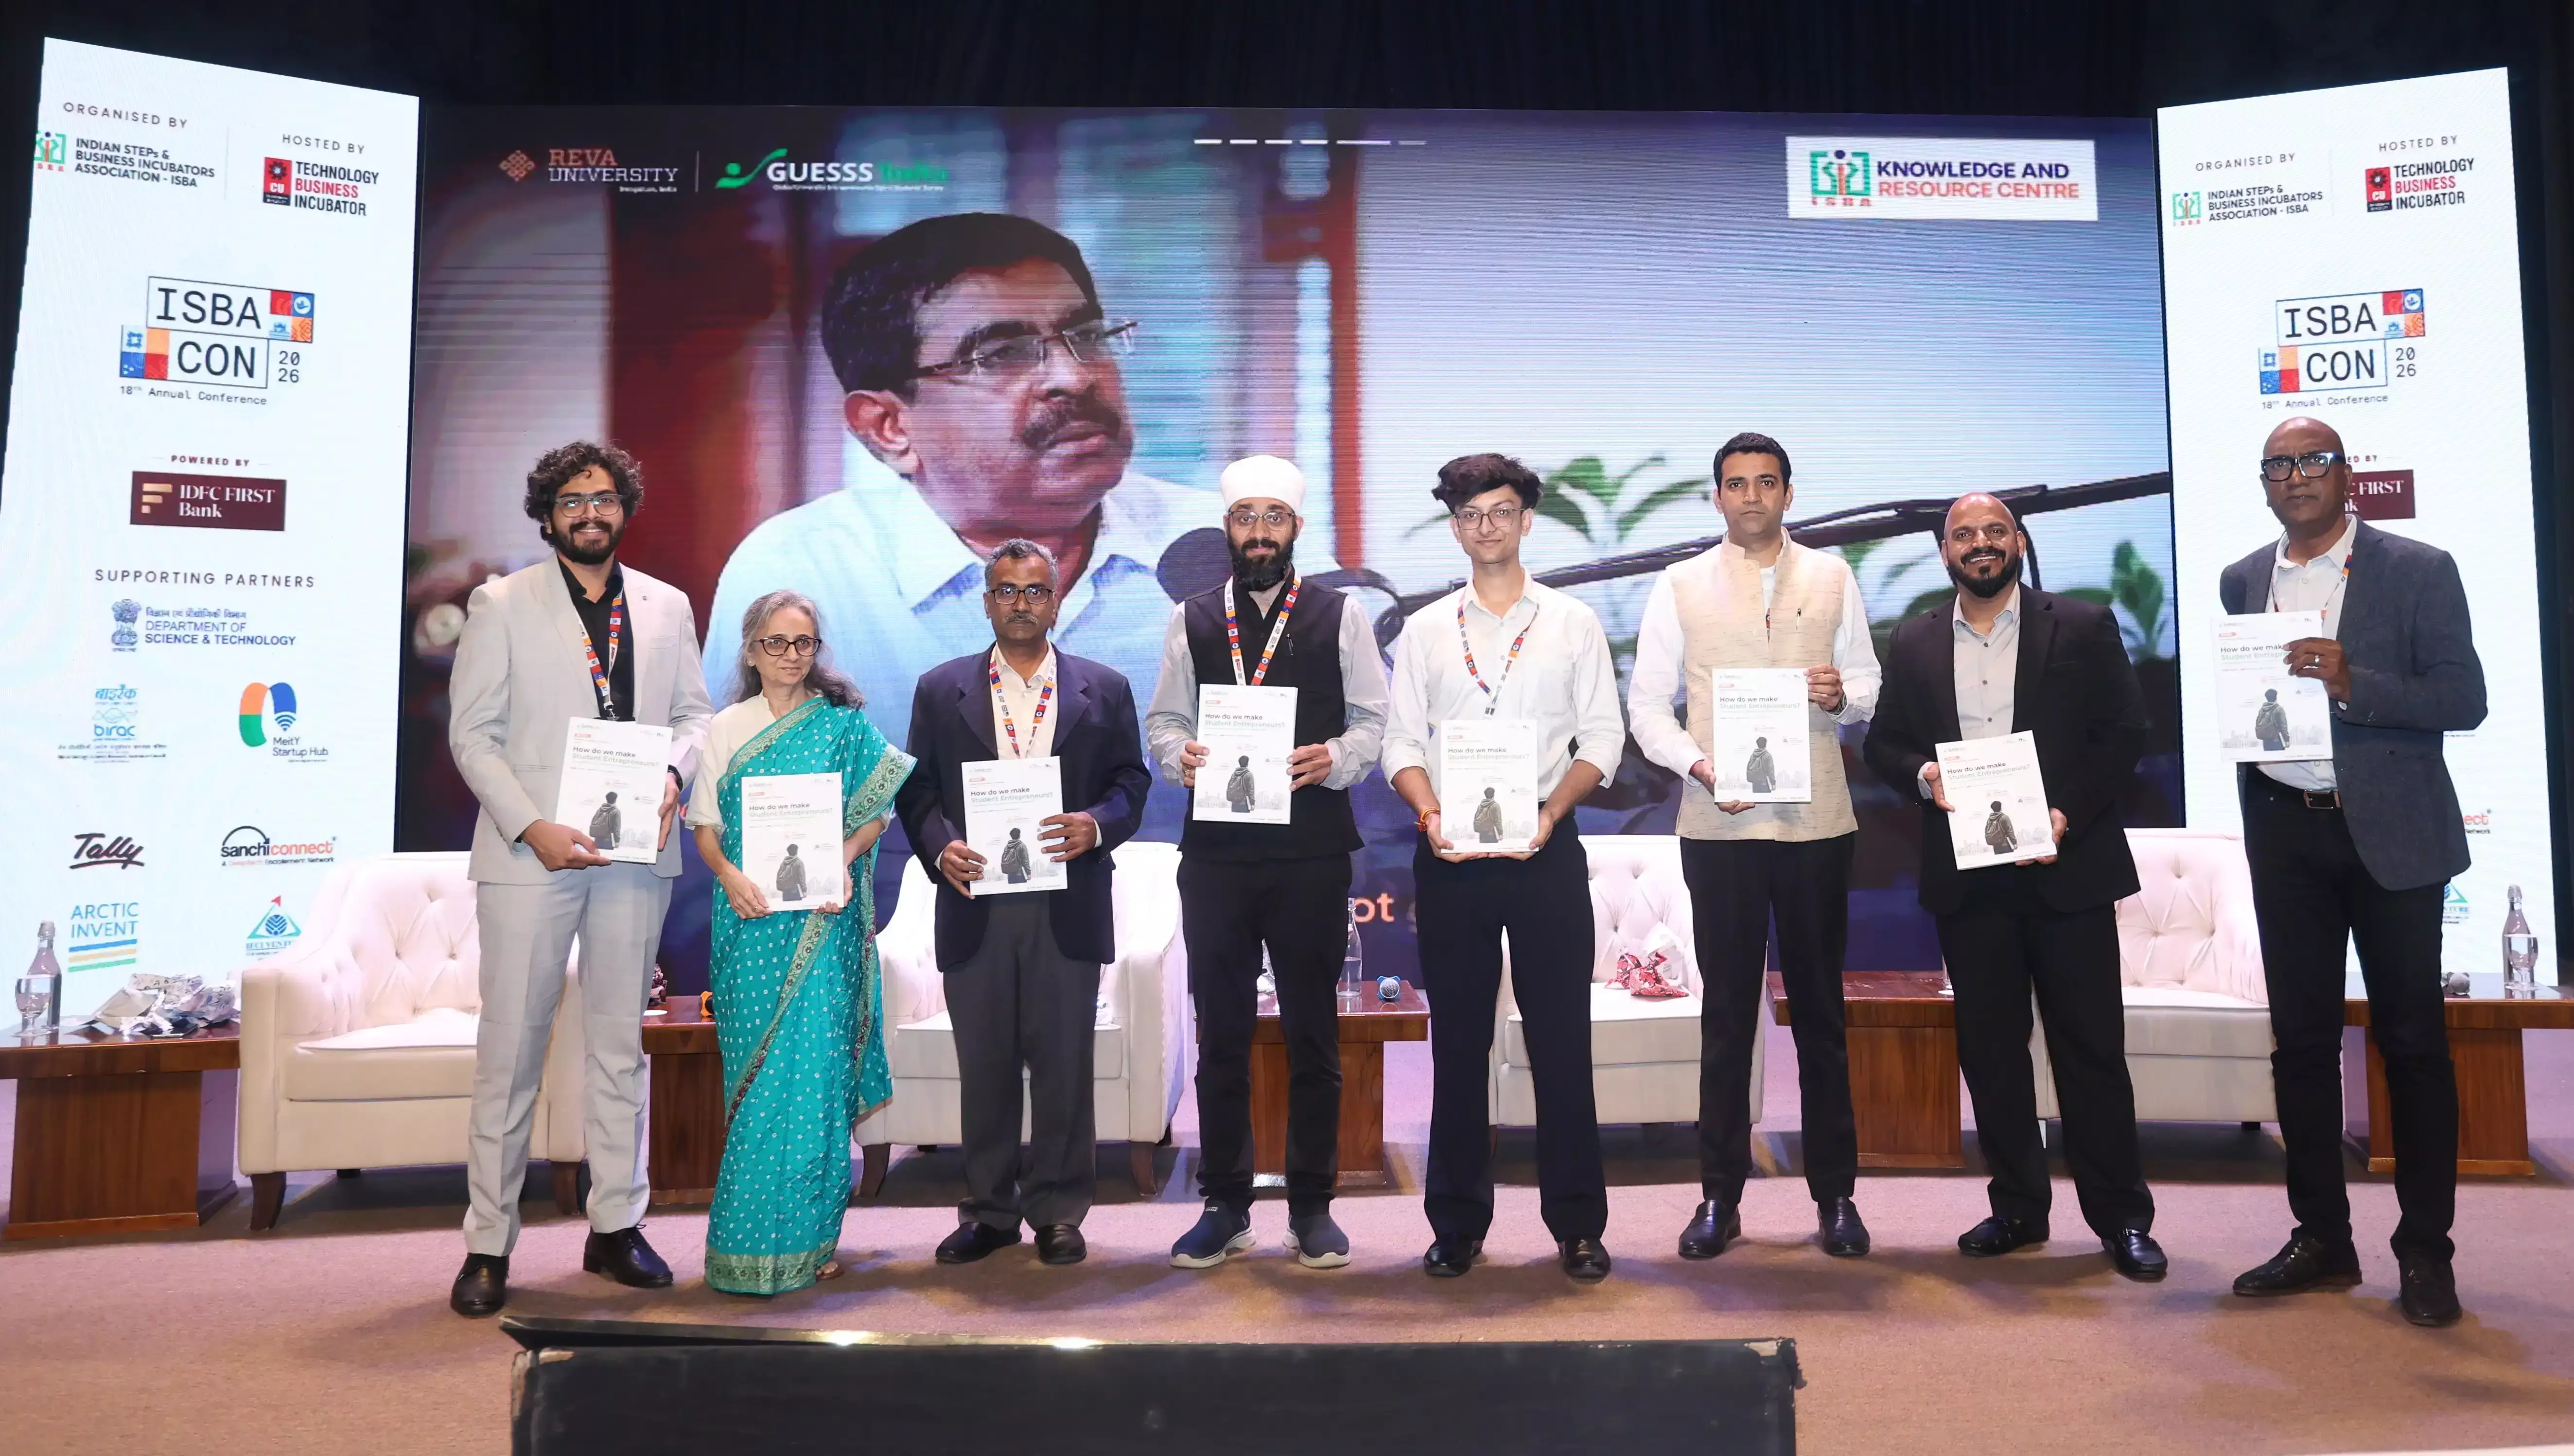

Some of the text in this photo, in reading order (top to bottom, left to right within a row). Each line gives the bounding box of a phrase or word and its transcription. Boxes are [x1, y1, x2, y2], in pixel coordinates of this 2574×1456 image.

[63, 102, 187, 128] ORGANISED BY
[76, 138, 170, 159] INDIAN STEPs &
[282, 134, 364, 154] HOSTED BY
[2379, 135, 2457, 152] HOSTED BY
[75, 150, 215, 177] BUSINESS INCUBATORS
[548, 149, 618, 166] REVA
[2195, 152, 2295, 172] ORGANISED BY
[75, 163, 160, 182] ASSOCIATION
[171, 175, 197, 187] ISBA
[296, 161, 379, 184] TECHNOLOGY
[548, 168, 678, 182] UNIVERSITY
[767, 162, 874, 182] GUESSS
[1876, 161, 2069, 179] KNOWLEDGE AND
[2394, 157, 2474, 178] TECHNOLOGY
[270, 182, 285, 193] CU
[295, 178, 358, 198] BUSINESS
[1879, 181, 2079, 199] RESOURCE CENTRE
[2207, 189, 2243, 200] INDIAN
[2246, 186, 2274, 195] STEPs
[2395, 175, 2456, 193] BUSINESS
[1811, 197, 1872, 207] ISBA
[2208, 191, 2323, 210] BUSINESS INCUBATORS
[2372, 190, 2385, 200] CU
[2396, 191, 2465, 209] INCUBATOR
[295, 195, 367, 216] INCUBATOR
[2209, 207, 2277, 221] ASSOCIATION
[2287, 204, 2309, 214] ISBA
[156, 288, 261, 329] ISBA
[2284, 303, 2377, 338] ISBA
[177, 341, 255, 378] CON
[279, 351, 300, 365] 20
[2396, 347, 2415, 361] 20
[2307, 349, 2375, 382] CON
[2396, 364, 2416, 378] 26
[278, 368, 299, 382] 26
[148, 388, 191, 399] Annual
[198, 391, 266, 405] Conference
[2285, 398, 2321, 407] Annual
[2328, 395, 2388, 405] Conference
[172, 455, 229, 466] POWERED
[179, 485, 276, 503] IDFC FIRST
[2359, 480, 2404, 495] FIRST
[179, 502, 222, 518] Bank
[95, 569, 315, 588] SUPPORTING PARTNERS
[146, 621, 246, 632] DEPARTMENT OF
[145, 634, 296, 645] SCIENCE & TECHNOLOGY
[273, 737, 300, 745] MeitY
[273, 747, 329, 758] Startup Hub
[73, 832, 144, 869] Tally
[221, 841, 333, 857] sanchiconnect
[70, 902, 139, 919] ARCTIC
[71, 920, 139, 938] INVENT
